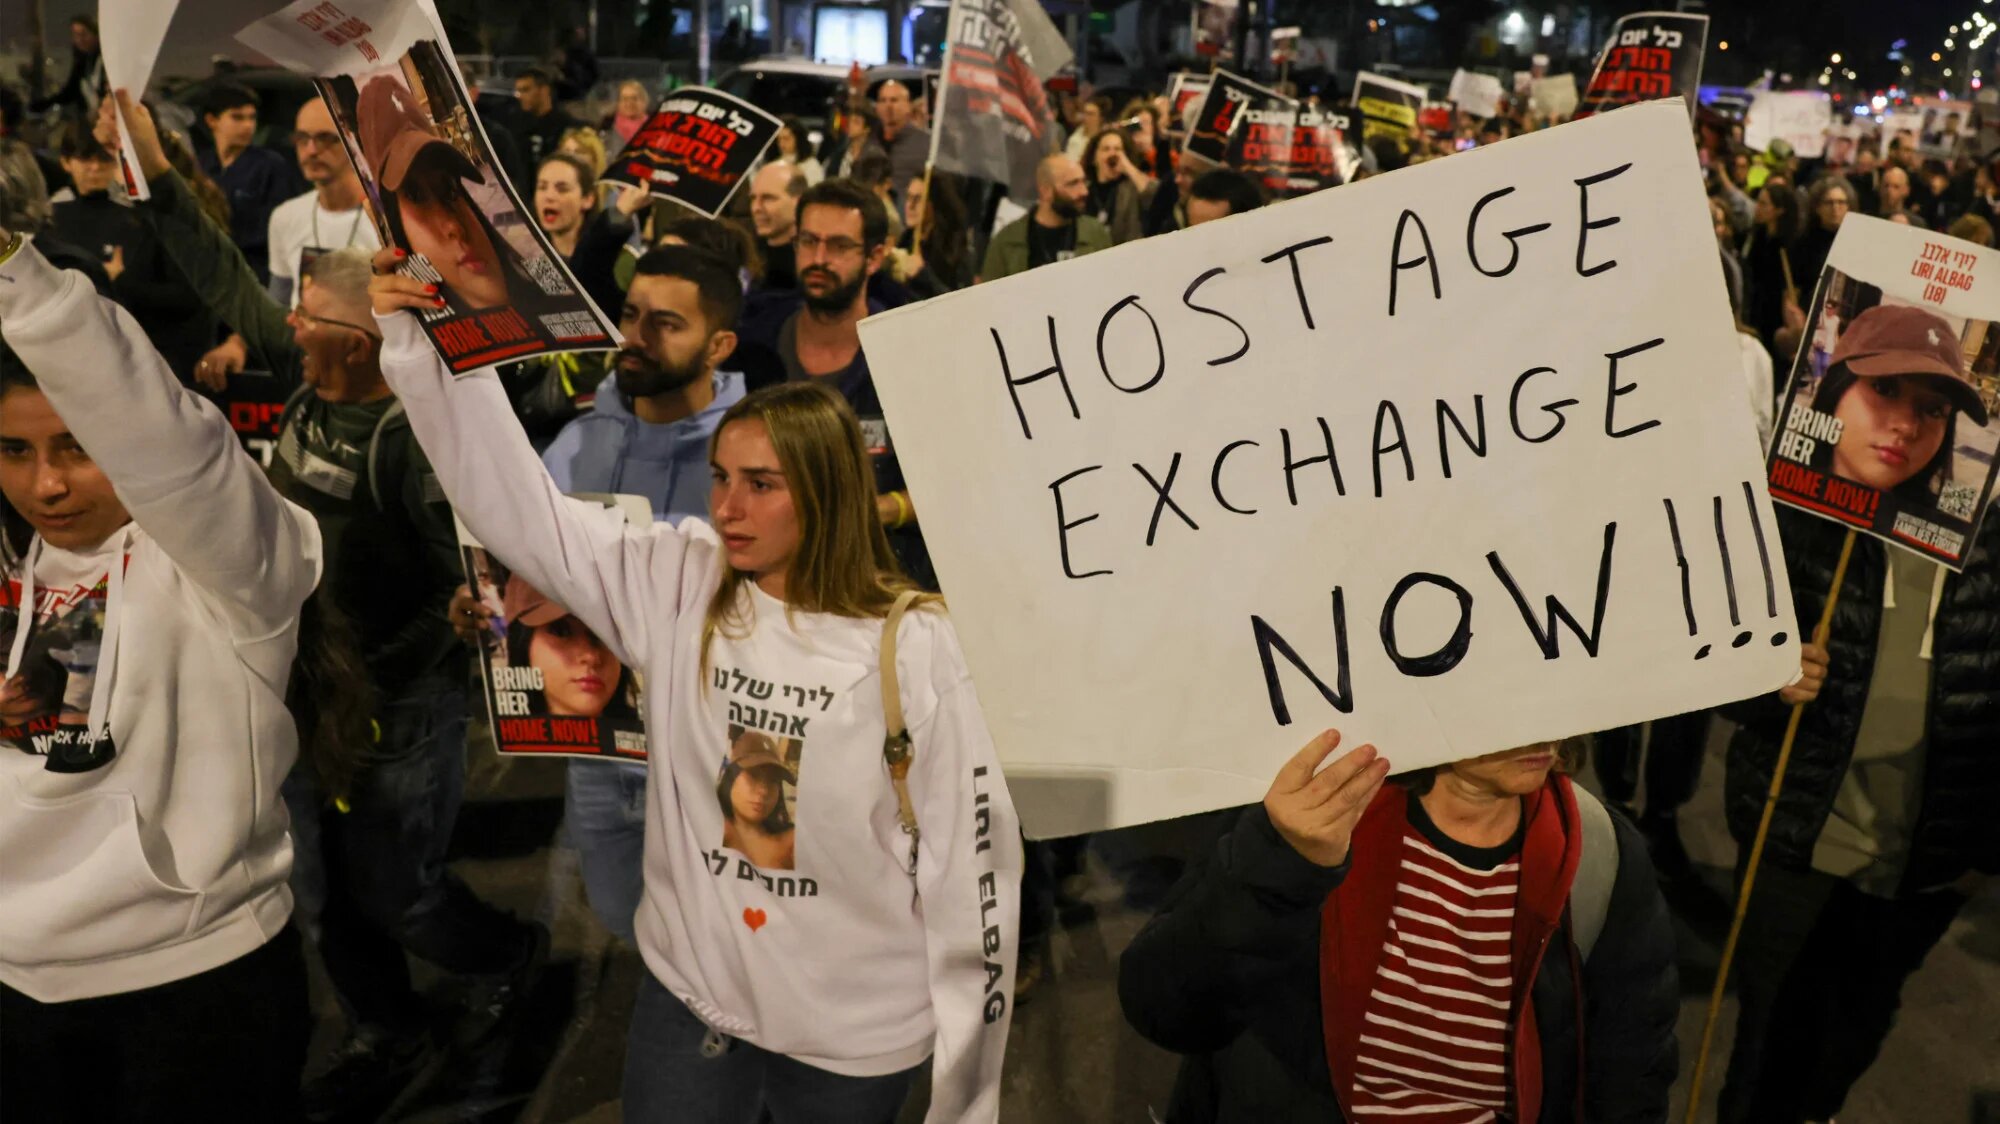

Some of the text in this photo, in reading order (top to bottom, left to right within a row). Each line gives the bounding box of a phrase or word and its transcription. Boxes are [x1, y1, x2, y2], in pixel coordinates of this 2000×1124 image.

[1620, 25, 1682, 48] כל יום
[1608, 47, 1671, 71] הורג
[696, 102, 726, 121] יום
[727, 110, 754, 136] כל
[1326, 111, 1350, 130] כל
[677, 114, 738, 150] הורג
[1919, 242, 1978, 271] לירי אלבג
[1911, 258, 1975, 291] LIRI ALBAG
[990, 162, 1633, 440] HOSTAGE
[1922, 284, 1947, 305] (18)
[432, 316, 492, 358] HOME
[479, 306, 538, 344] NOW!
[1786, 404, 1845, 446] BRING
[1047, 337, 1665, 579] EXCHANGE
[1777, 429, 1815, 467] HER
[1769, 461, 1881, 519] HOME NOW!
[492, 666, 544, 691] BRING
[713, 666, 834, 712] לירי שלנו
[496, 691, 531, 715] HER
[727, 701, 810, 738] אהובה
[499, 719, 549, 742] HOME
[551, 719, 600, 744] NOW!
[972, 765, 1006, 1026] LIRI ELBAG
